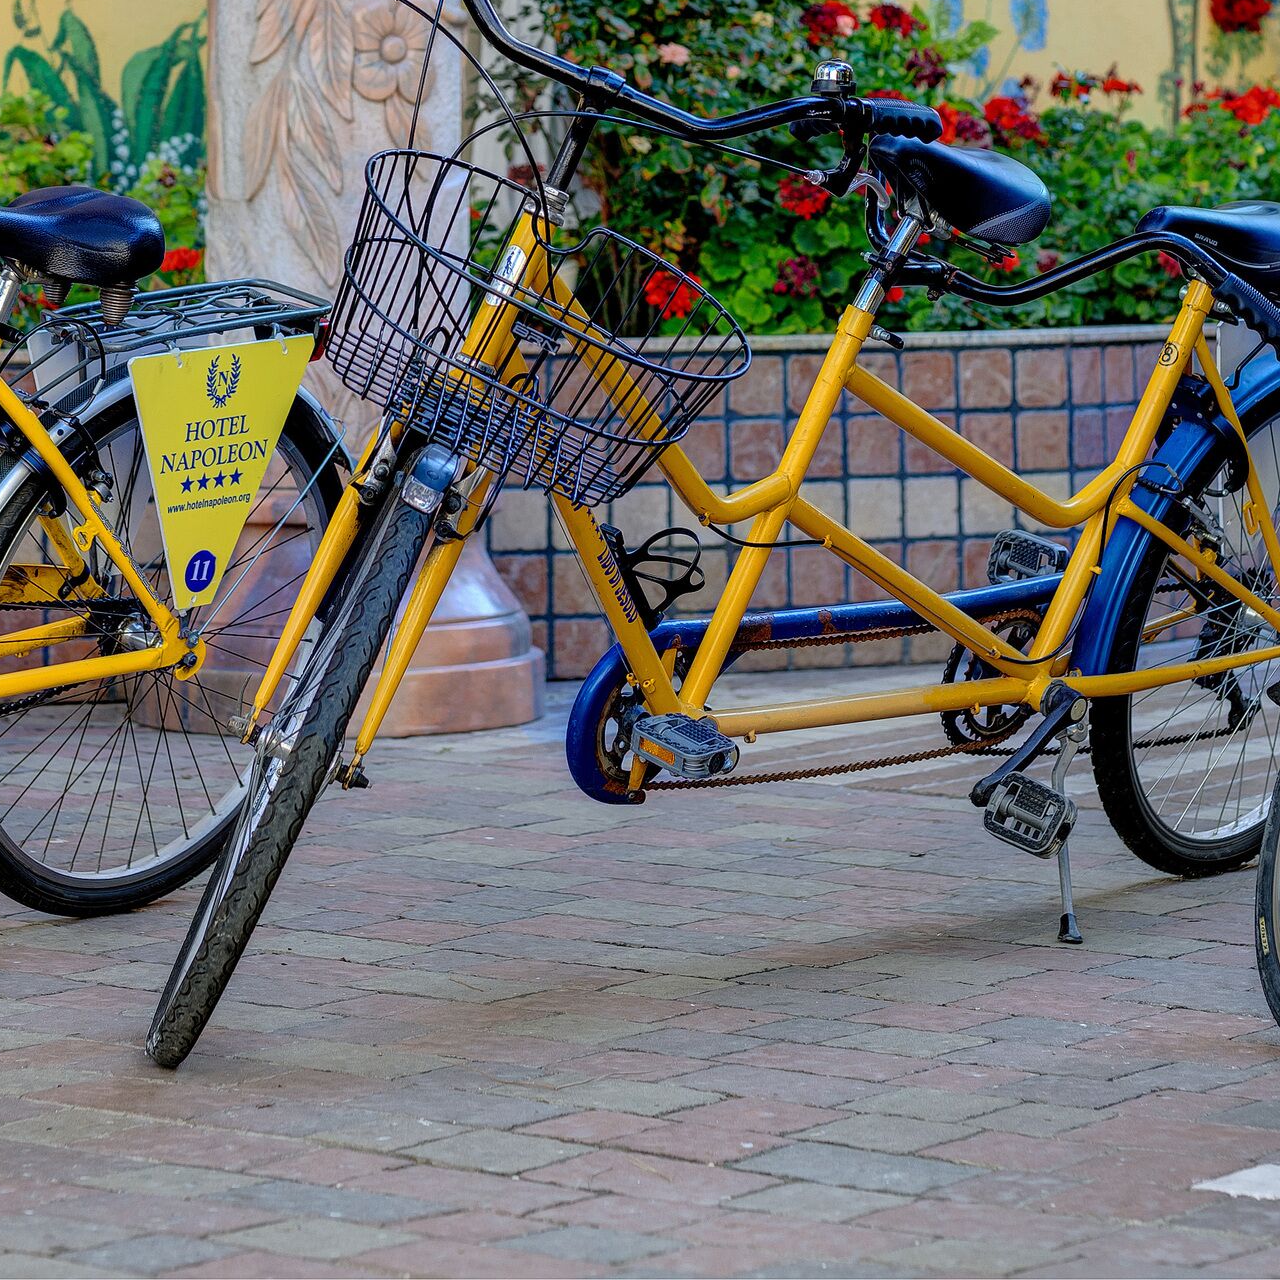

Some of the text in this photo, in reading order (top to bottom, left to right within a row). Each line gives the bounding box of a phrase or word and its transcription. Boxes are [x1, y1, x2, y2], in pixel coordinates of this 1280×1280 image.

[512, 324, 559, 354] BRN
[217, 370, 230, 387] N
[184, 414, 250, 443] HOTEL
[160, 438, 269, 475] NAPOLEON
[167, 493, 251, 514] www.hotelnapoleon.org
[190, 559, 211, 582] 11
[597, 545, 619, 576] LIDO
[615, 583, 639, 624] JESOLO
[1260, 920, 1268, 950] KENDA
